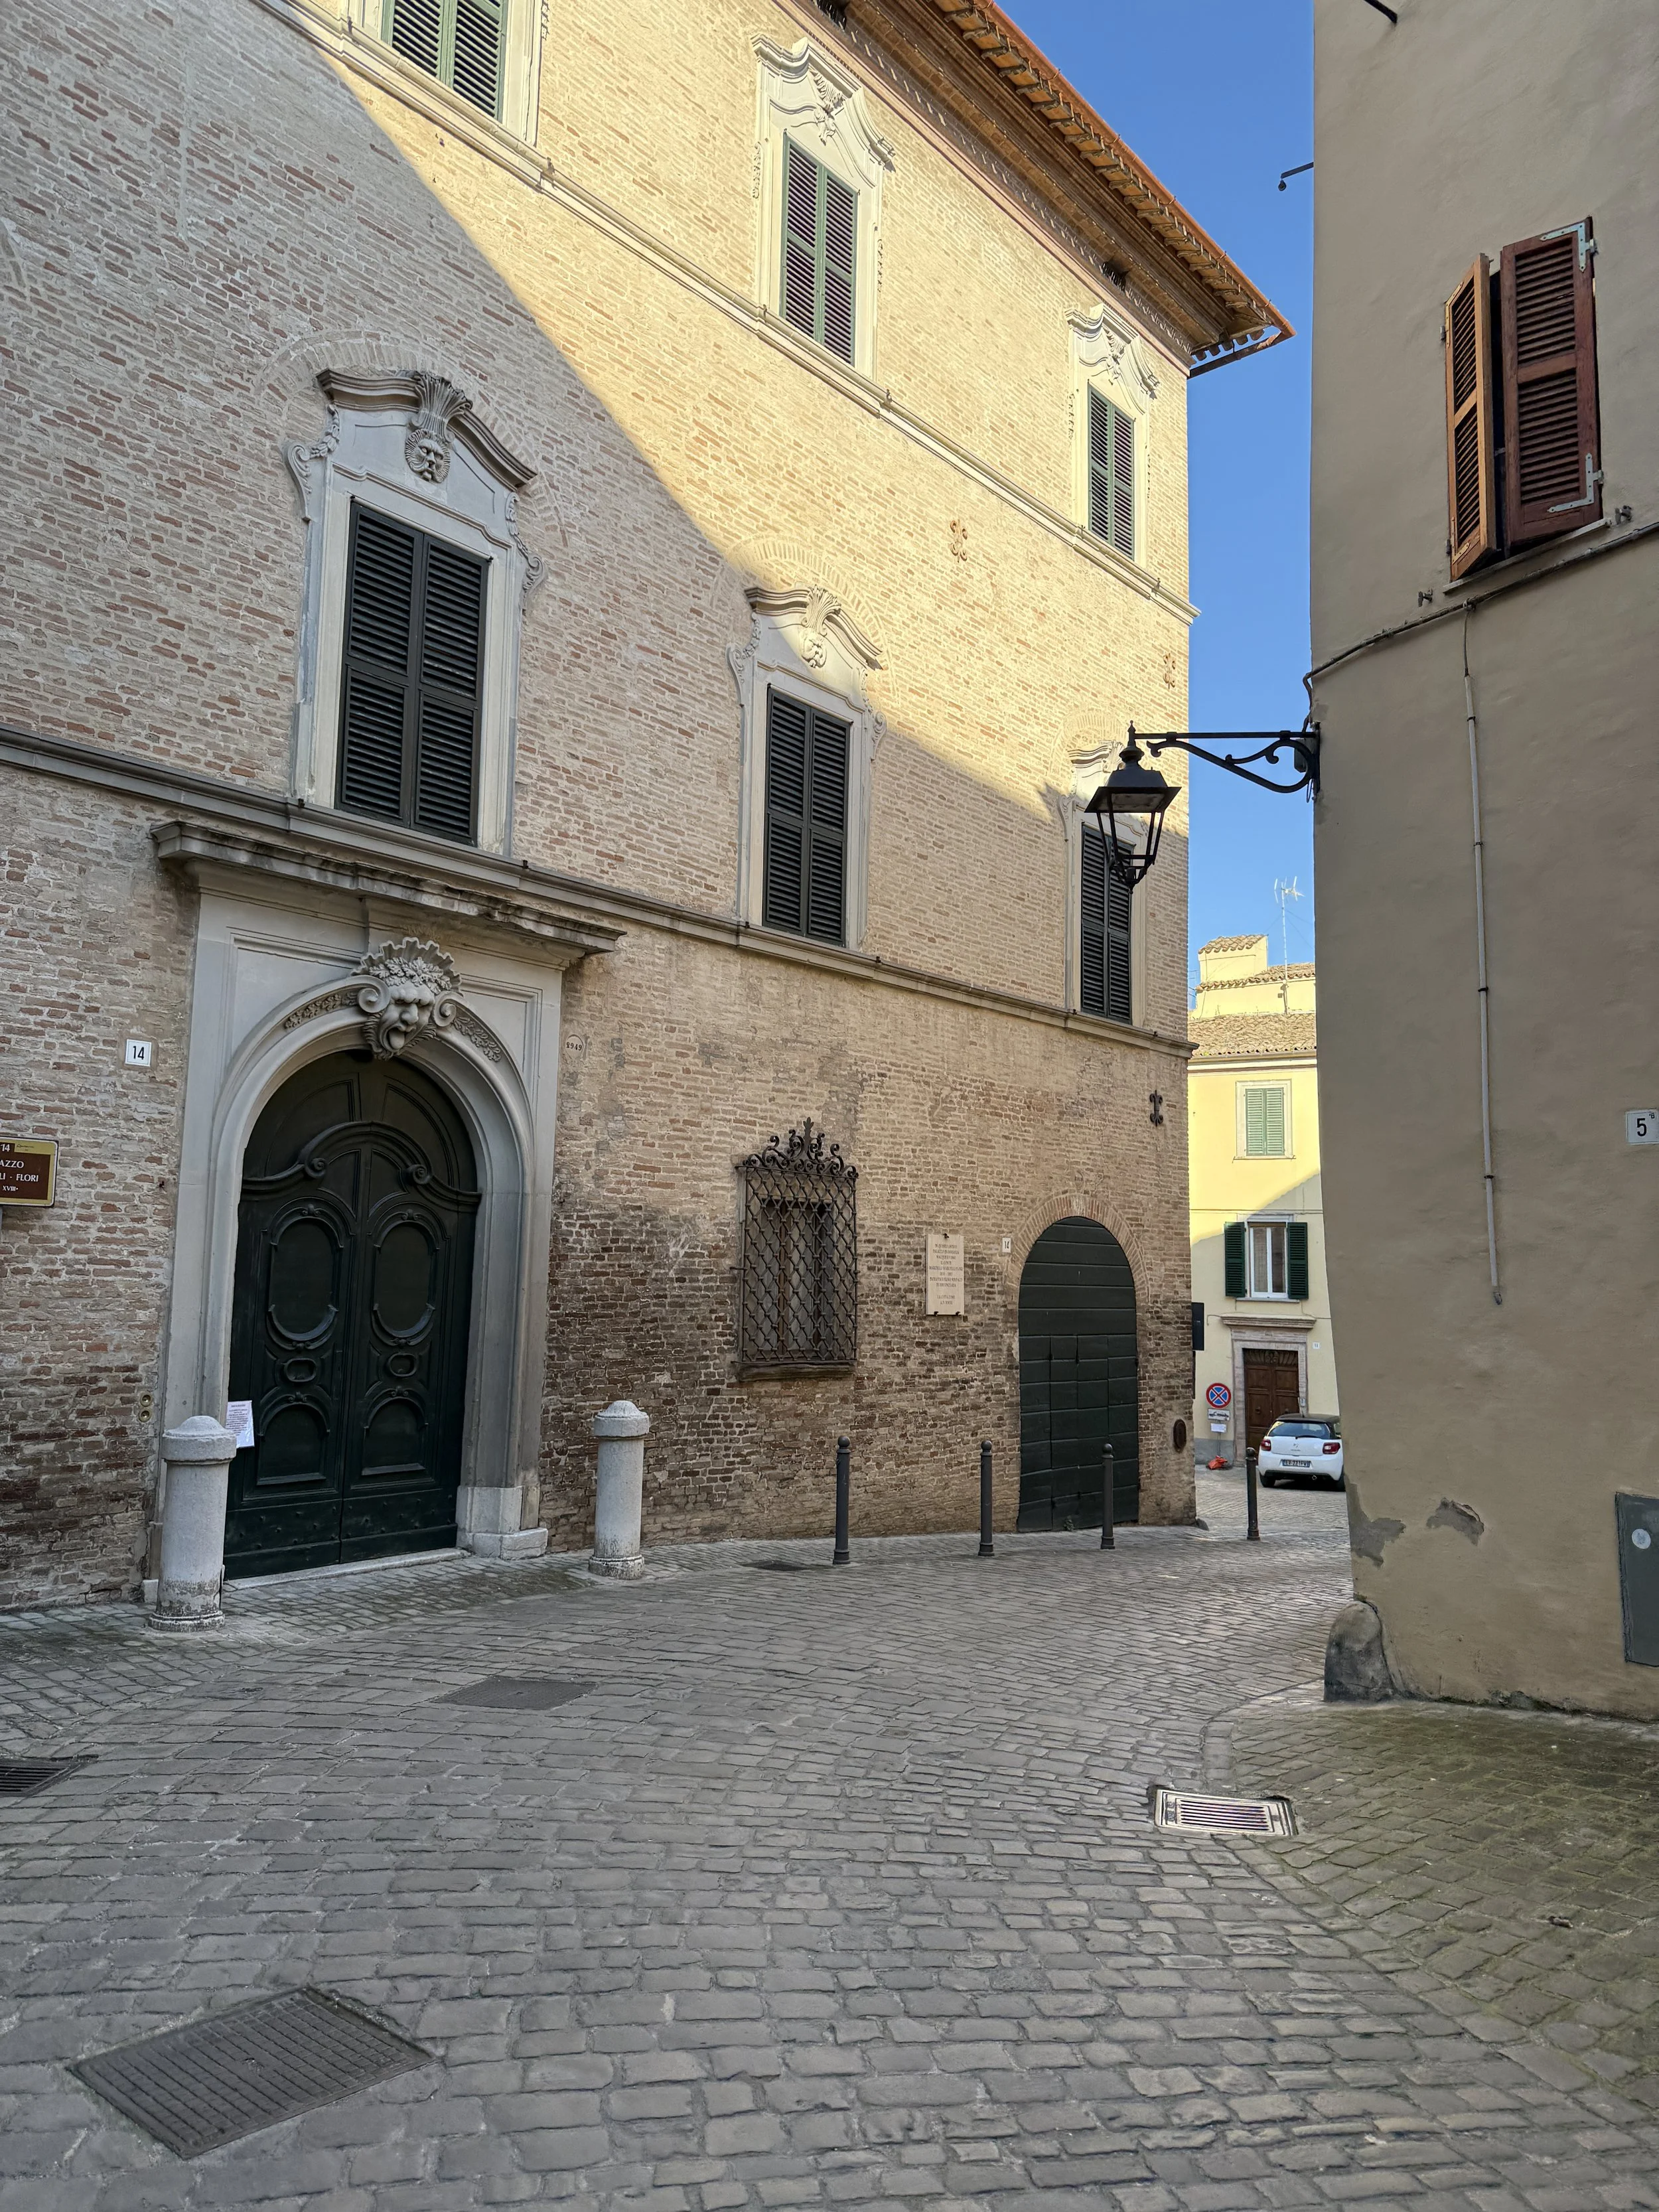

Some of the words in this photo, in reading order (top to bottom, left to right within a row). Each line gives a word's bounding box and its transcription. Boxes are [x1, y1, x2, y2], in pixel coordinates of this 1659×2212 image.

[566, 1042, 583, 1051] 2949
[133, 1045, 145, 1060] 14
[1636, 1118, 1646, 1136] 5
[1, 1143, 11, 1152] 14
[16, 1173, 39, 1182] FLORI
